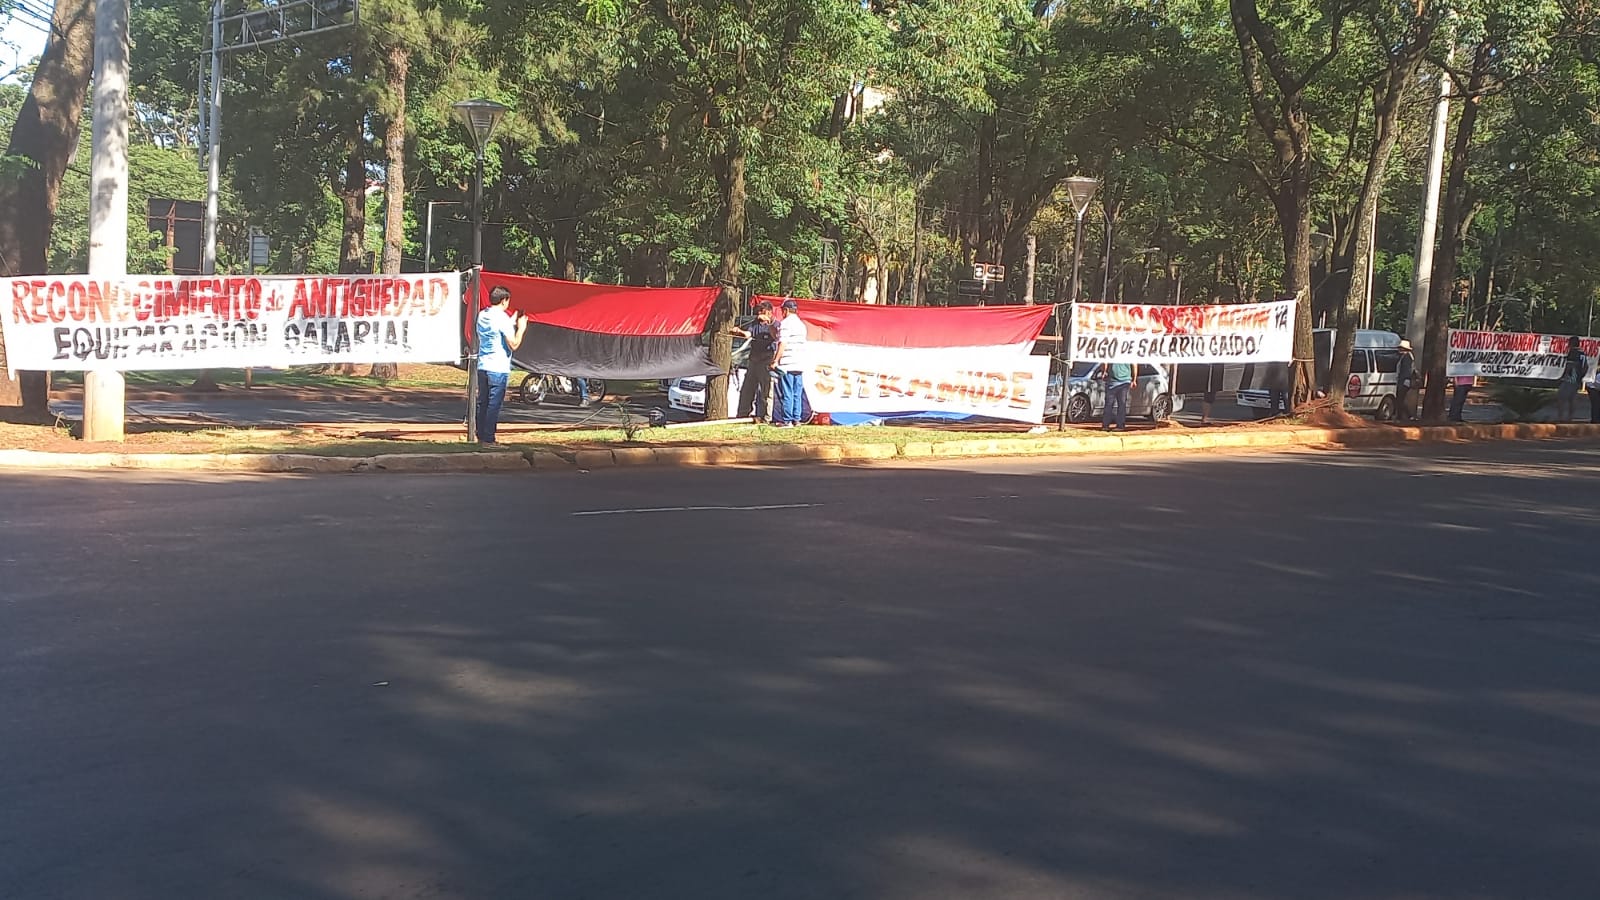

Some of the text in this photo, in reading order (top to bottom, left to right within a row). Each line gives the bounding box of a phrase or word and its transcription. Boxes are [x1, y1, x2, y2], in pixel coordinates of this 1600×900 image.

[12, 278, 262, 323] RECONOCIMIENTO
[1076, 336, 1117, 359] PAGO
[1137, 335, 1205, 358] SALARIO
[1450, 331, 1491, 350] CONTRATO
[1450, 350, 1513, 364] CUMPLIMIENTO
[1527, 353, 1568, 369] CONTRAT
[1481, 364, 1533, 376] COLECTIVO!
